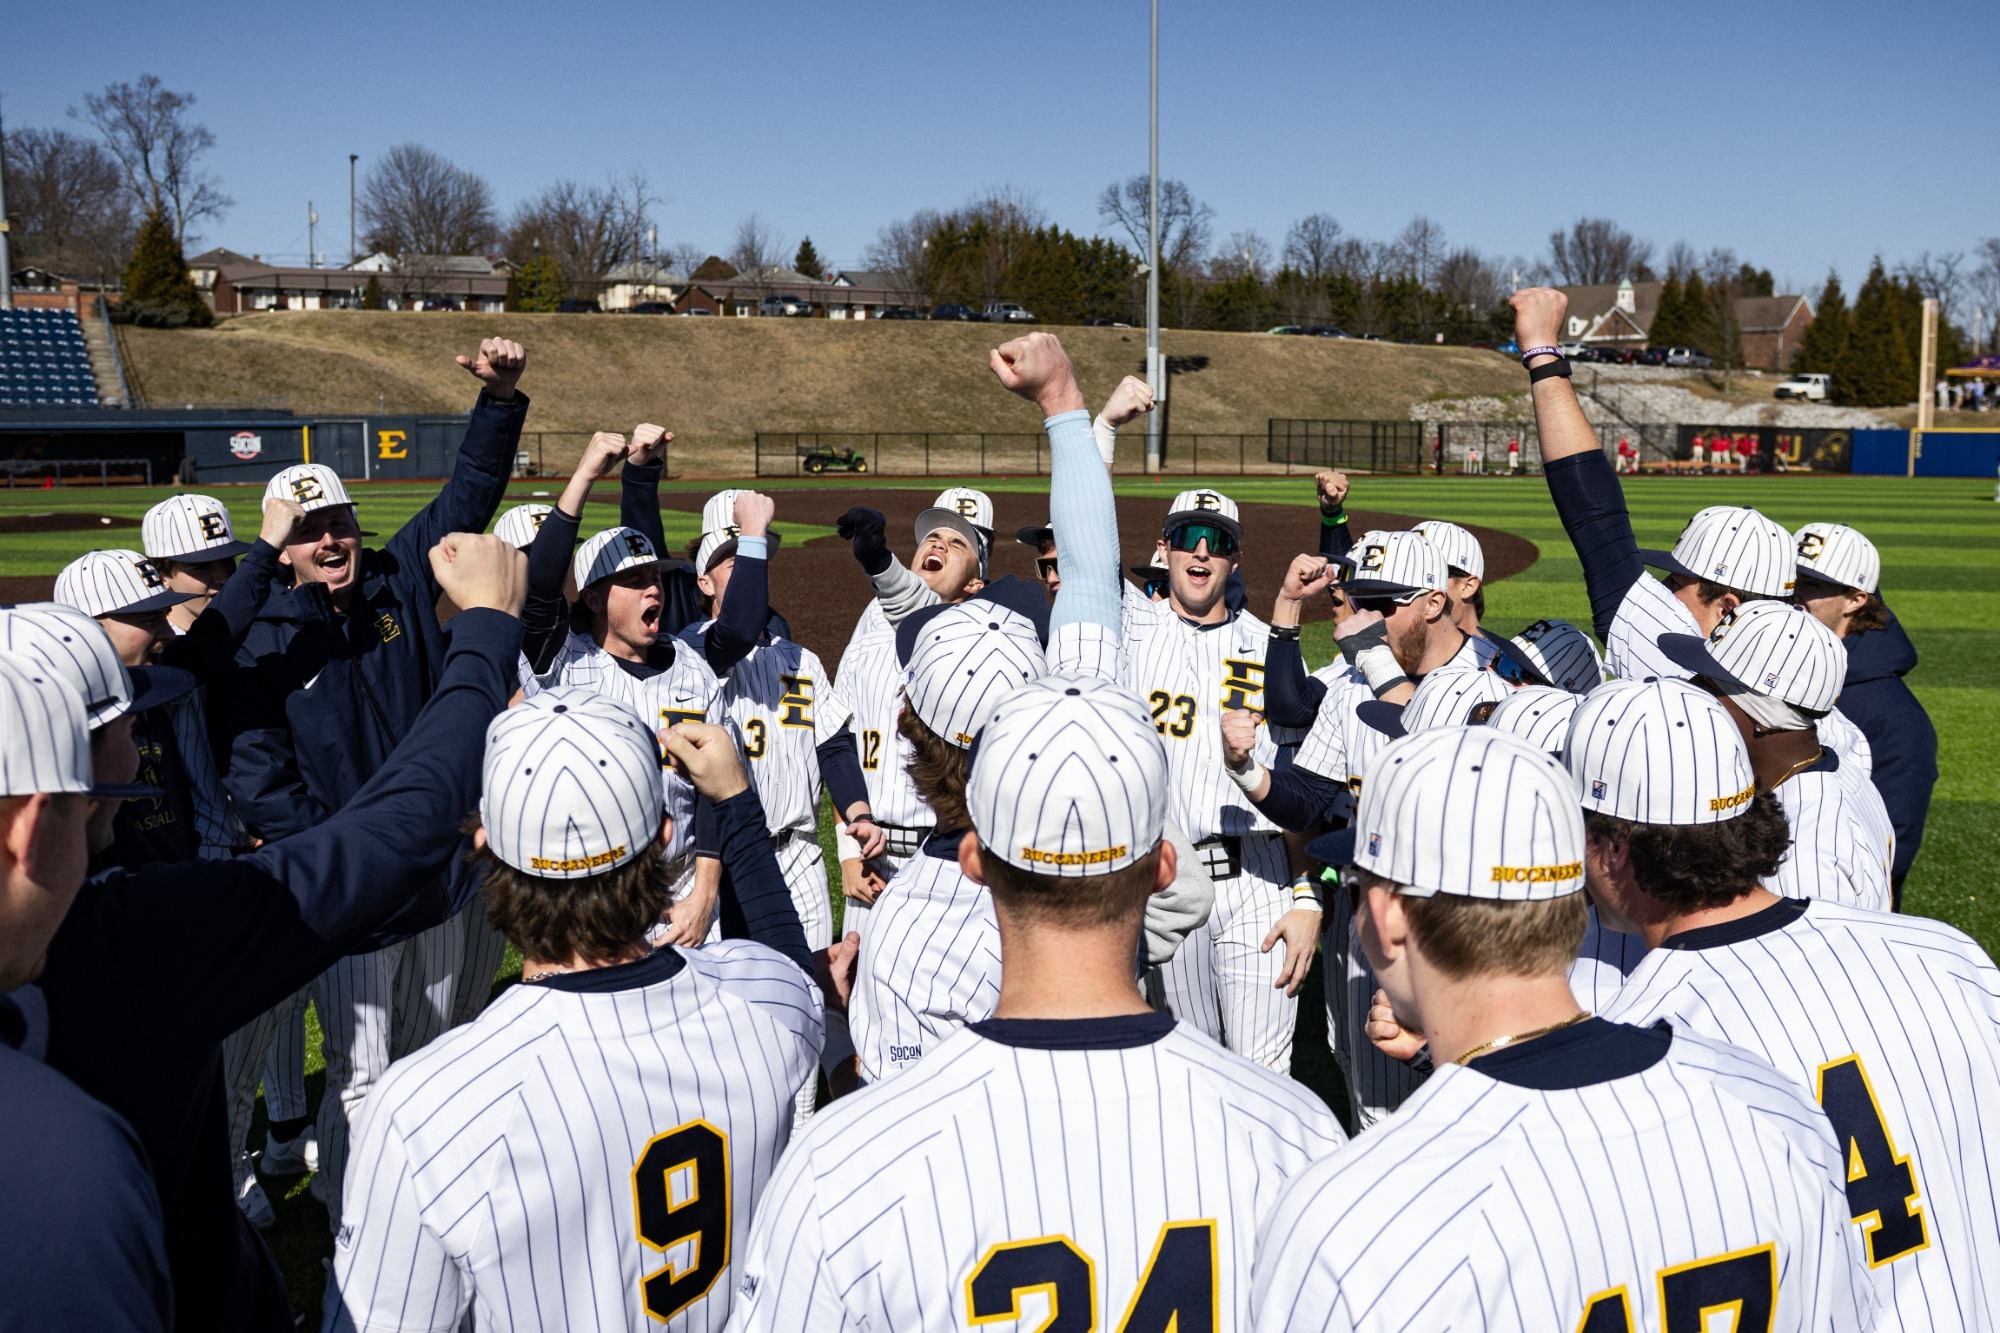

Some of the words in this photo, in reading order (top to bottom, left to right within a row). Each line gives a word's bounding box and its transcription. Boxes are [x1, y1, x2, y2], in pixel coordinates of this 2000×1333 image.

[377, 429, 408, 459] E
[290, 476, 325, 505] E
[956, 498, 977, 519] E
[198, 512, 230, 541] E
[1360, 544, 1387, 573] E
[1149, 690, 1197, 740] 23
[862, 728, 881, 771] 12
[530, 845, 626, 872] BUCCANEERS
[1021, 845, 1127, 866] BUCCANEERS
[630, 1118, 731, 1323] 9
[1574, 1241, 1779, 1333] 7
